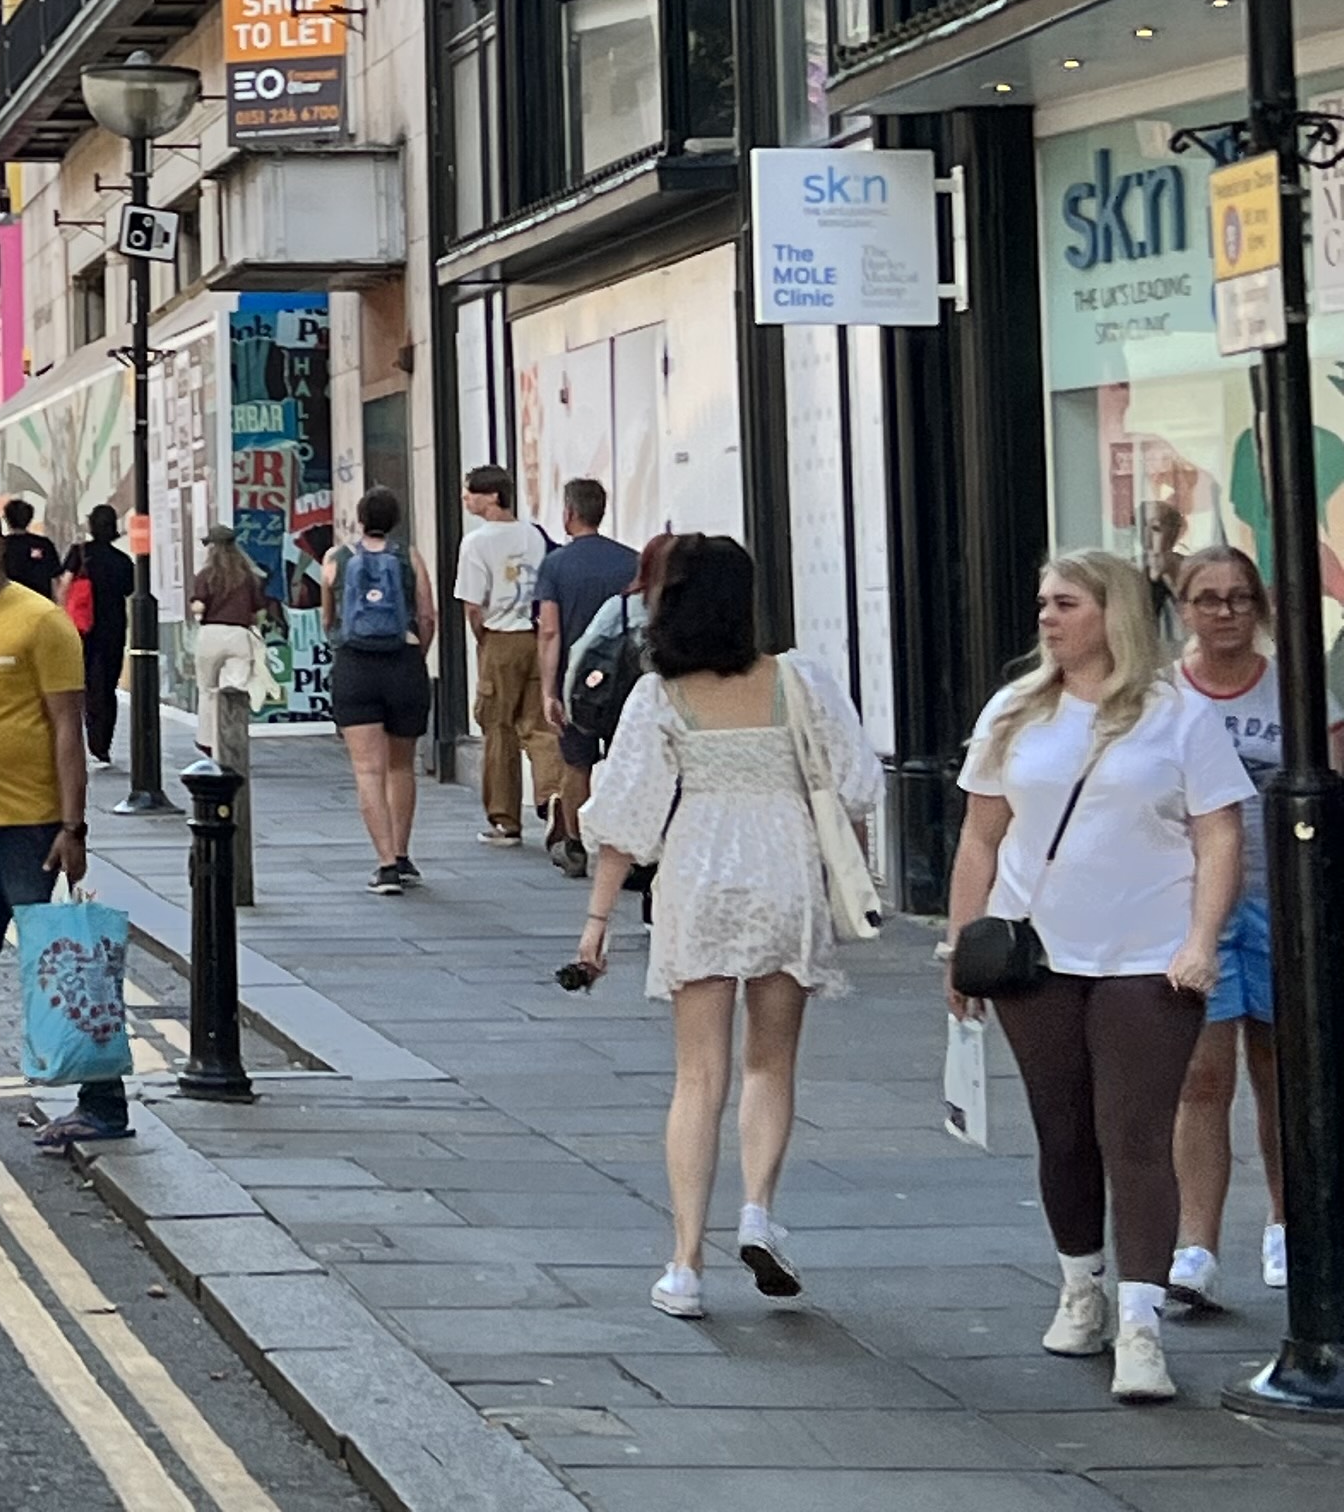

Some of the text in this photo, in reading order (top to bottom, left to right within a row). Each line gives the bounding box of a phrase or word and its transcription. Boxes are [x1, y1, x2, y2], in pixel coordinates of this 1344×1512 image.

[232, 17, 336, 50] TO LET
[773, 244, 814, 262] The
[773, 267, 837, 285] MOLE
[773, 289, 834, 307] Clinic
[231, 404, 284, 433] RBAR
